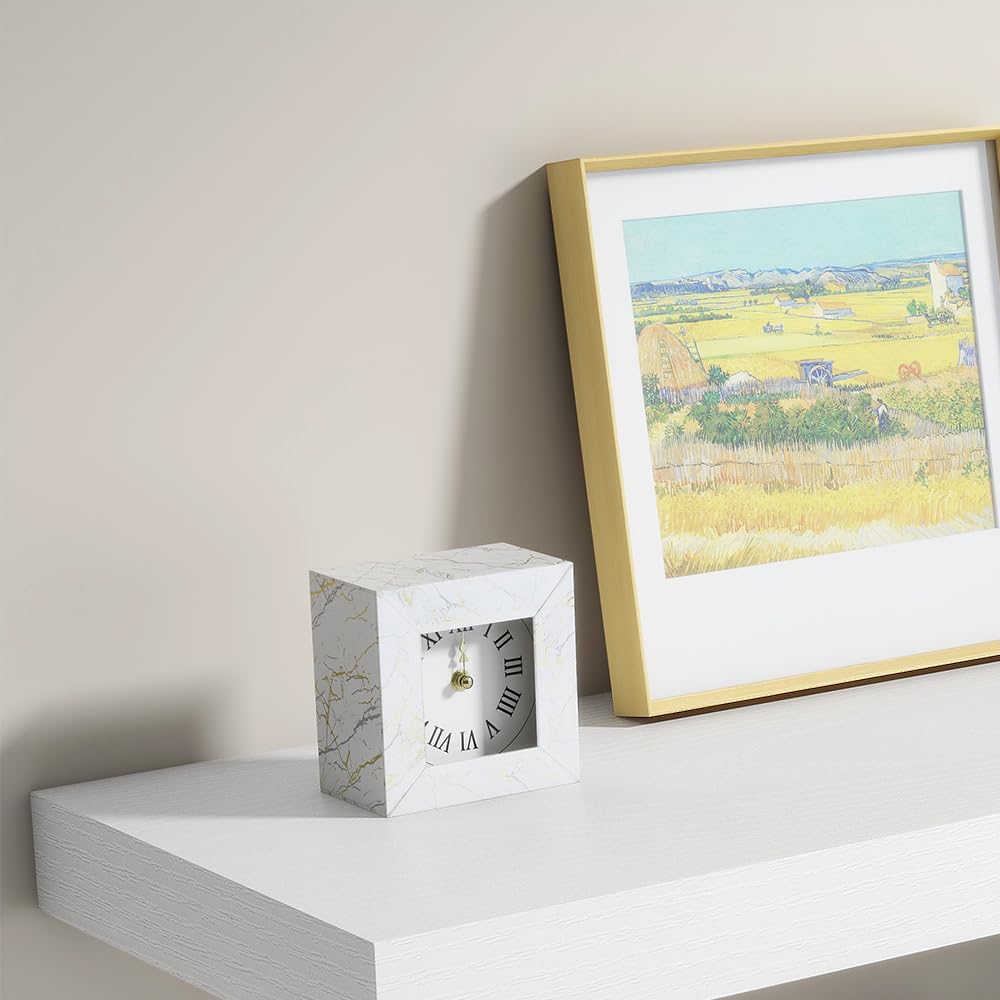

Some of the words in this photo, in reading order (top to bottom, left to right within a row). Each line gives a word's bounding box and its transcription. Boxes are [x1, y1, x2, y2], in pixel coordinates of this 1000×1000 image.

[493, 629, 514, 651] II
[503, 655, 523, 678] III
[495, 686, 522, 718] IIII
[426, 725, 452, 754] VII
[460, 729, 479, 751] VI
[485, 719, 501, 740] V
